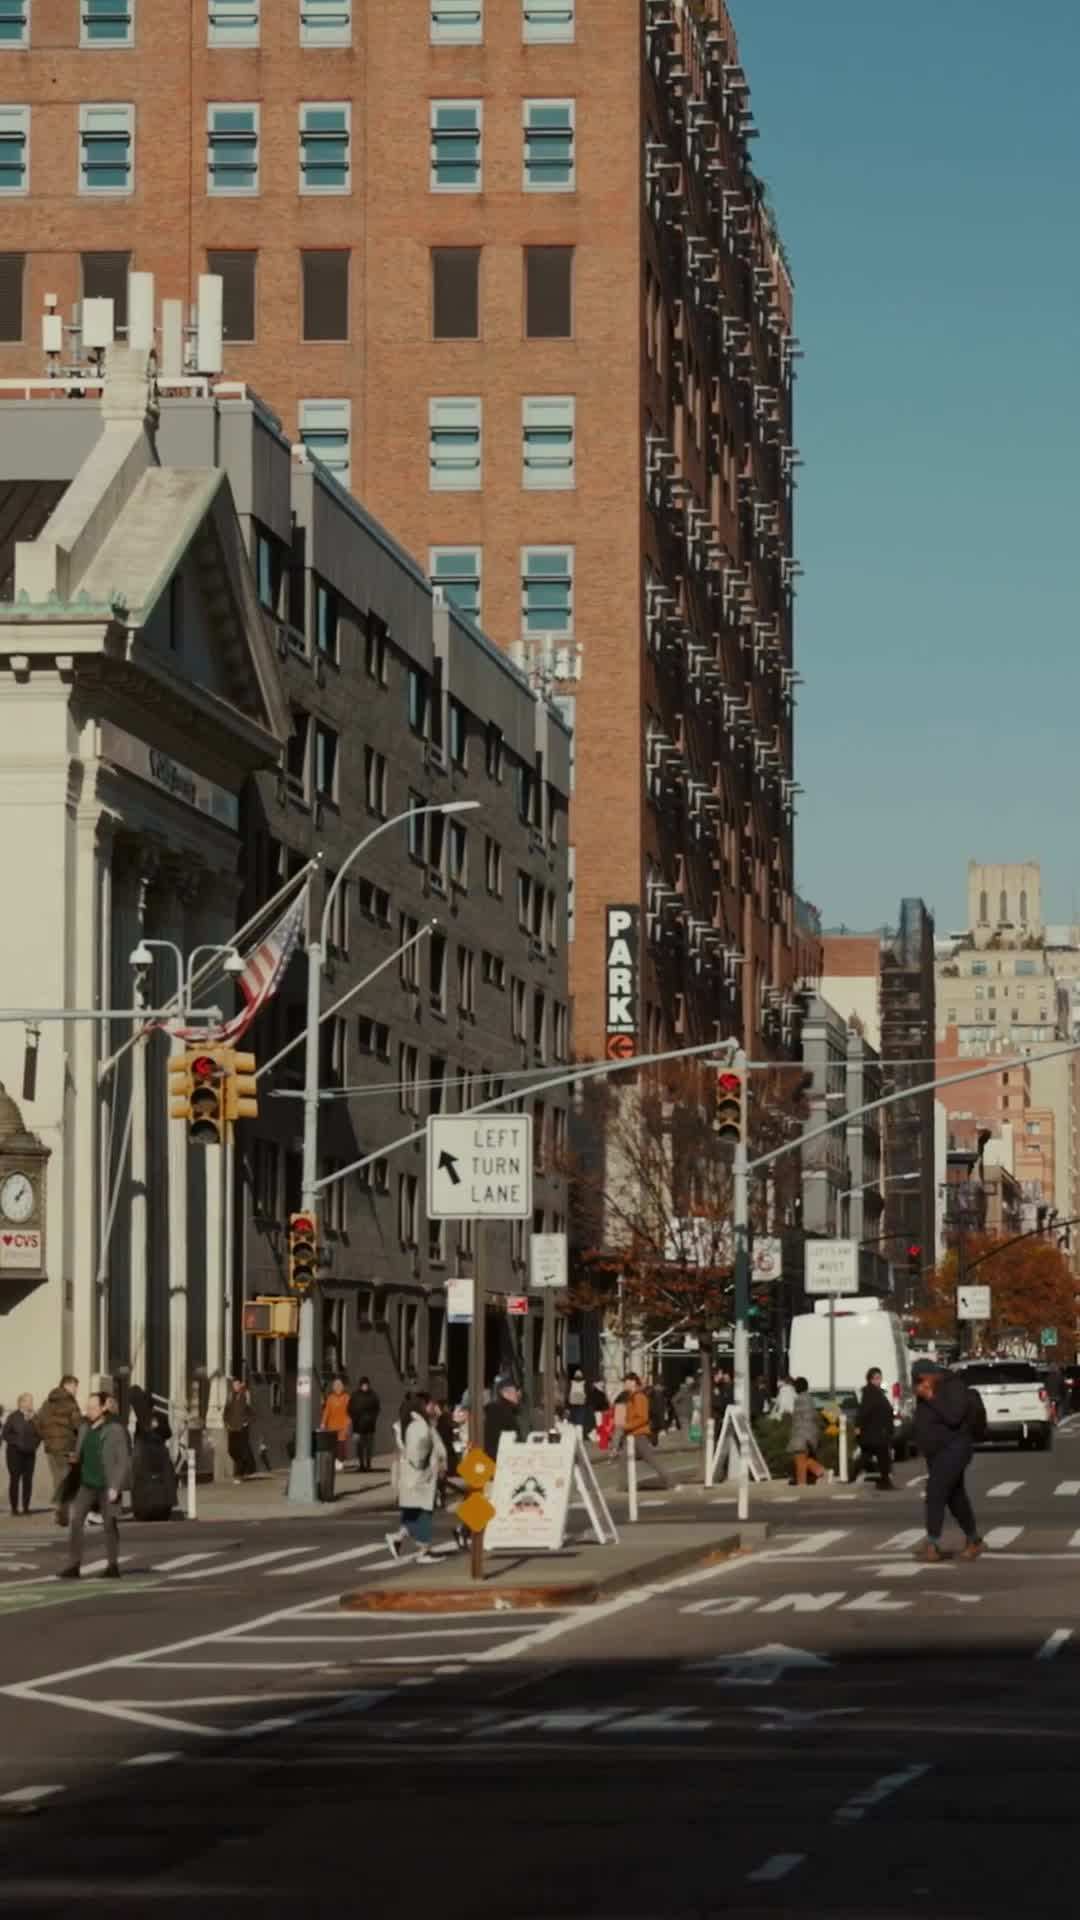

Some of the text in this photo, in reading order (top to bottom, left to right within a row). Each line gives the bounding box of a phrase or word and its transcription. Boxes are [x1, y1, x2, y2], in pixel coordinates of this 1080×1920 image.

[608, 910, 633, 1024] PARK
[473, 1129, 520, 1148] LEFT
[472, 1157, 520, 1175] TURN
[471, 1184, 521, 1203] LANE
[15, 1234, 38, 1248] CVS
